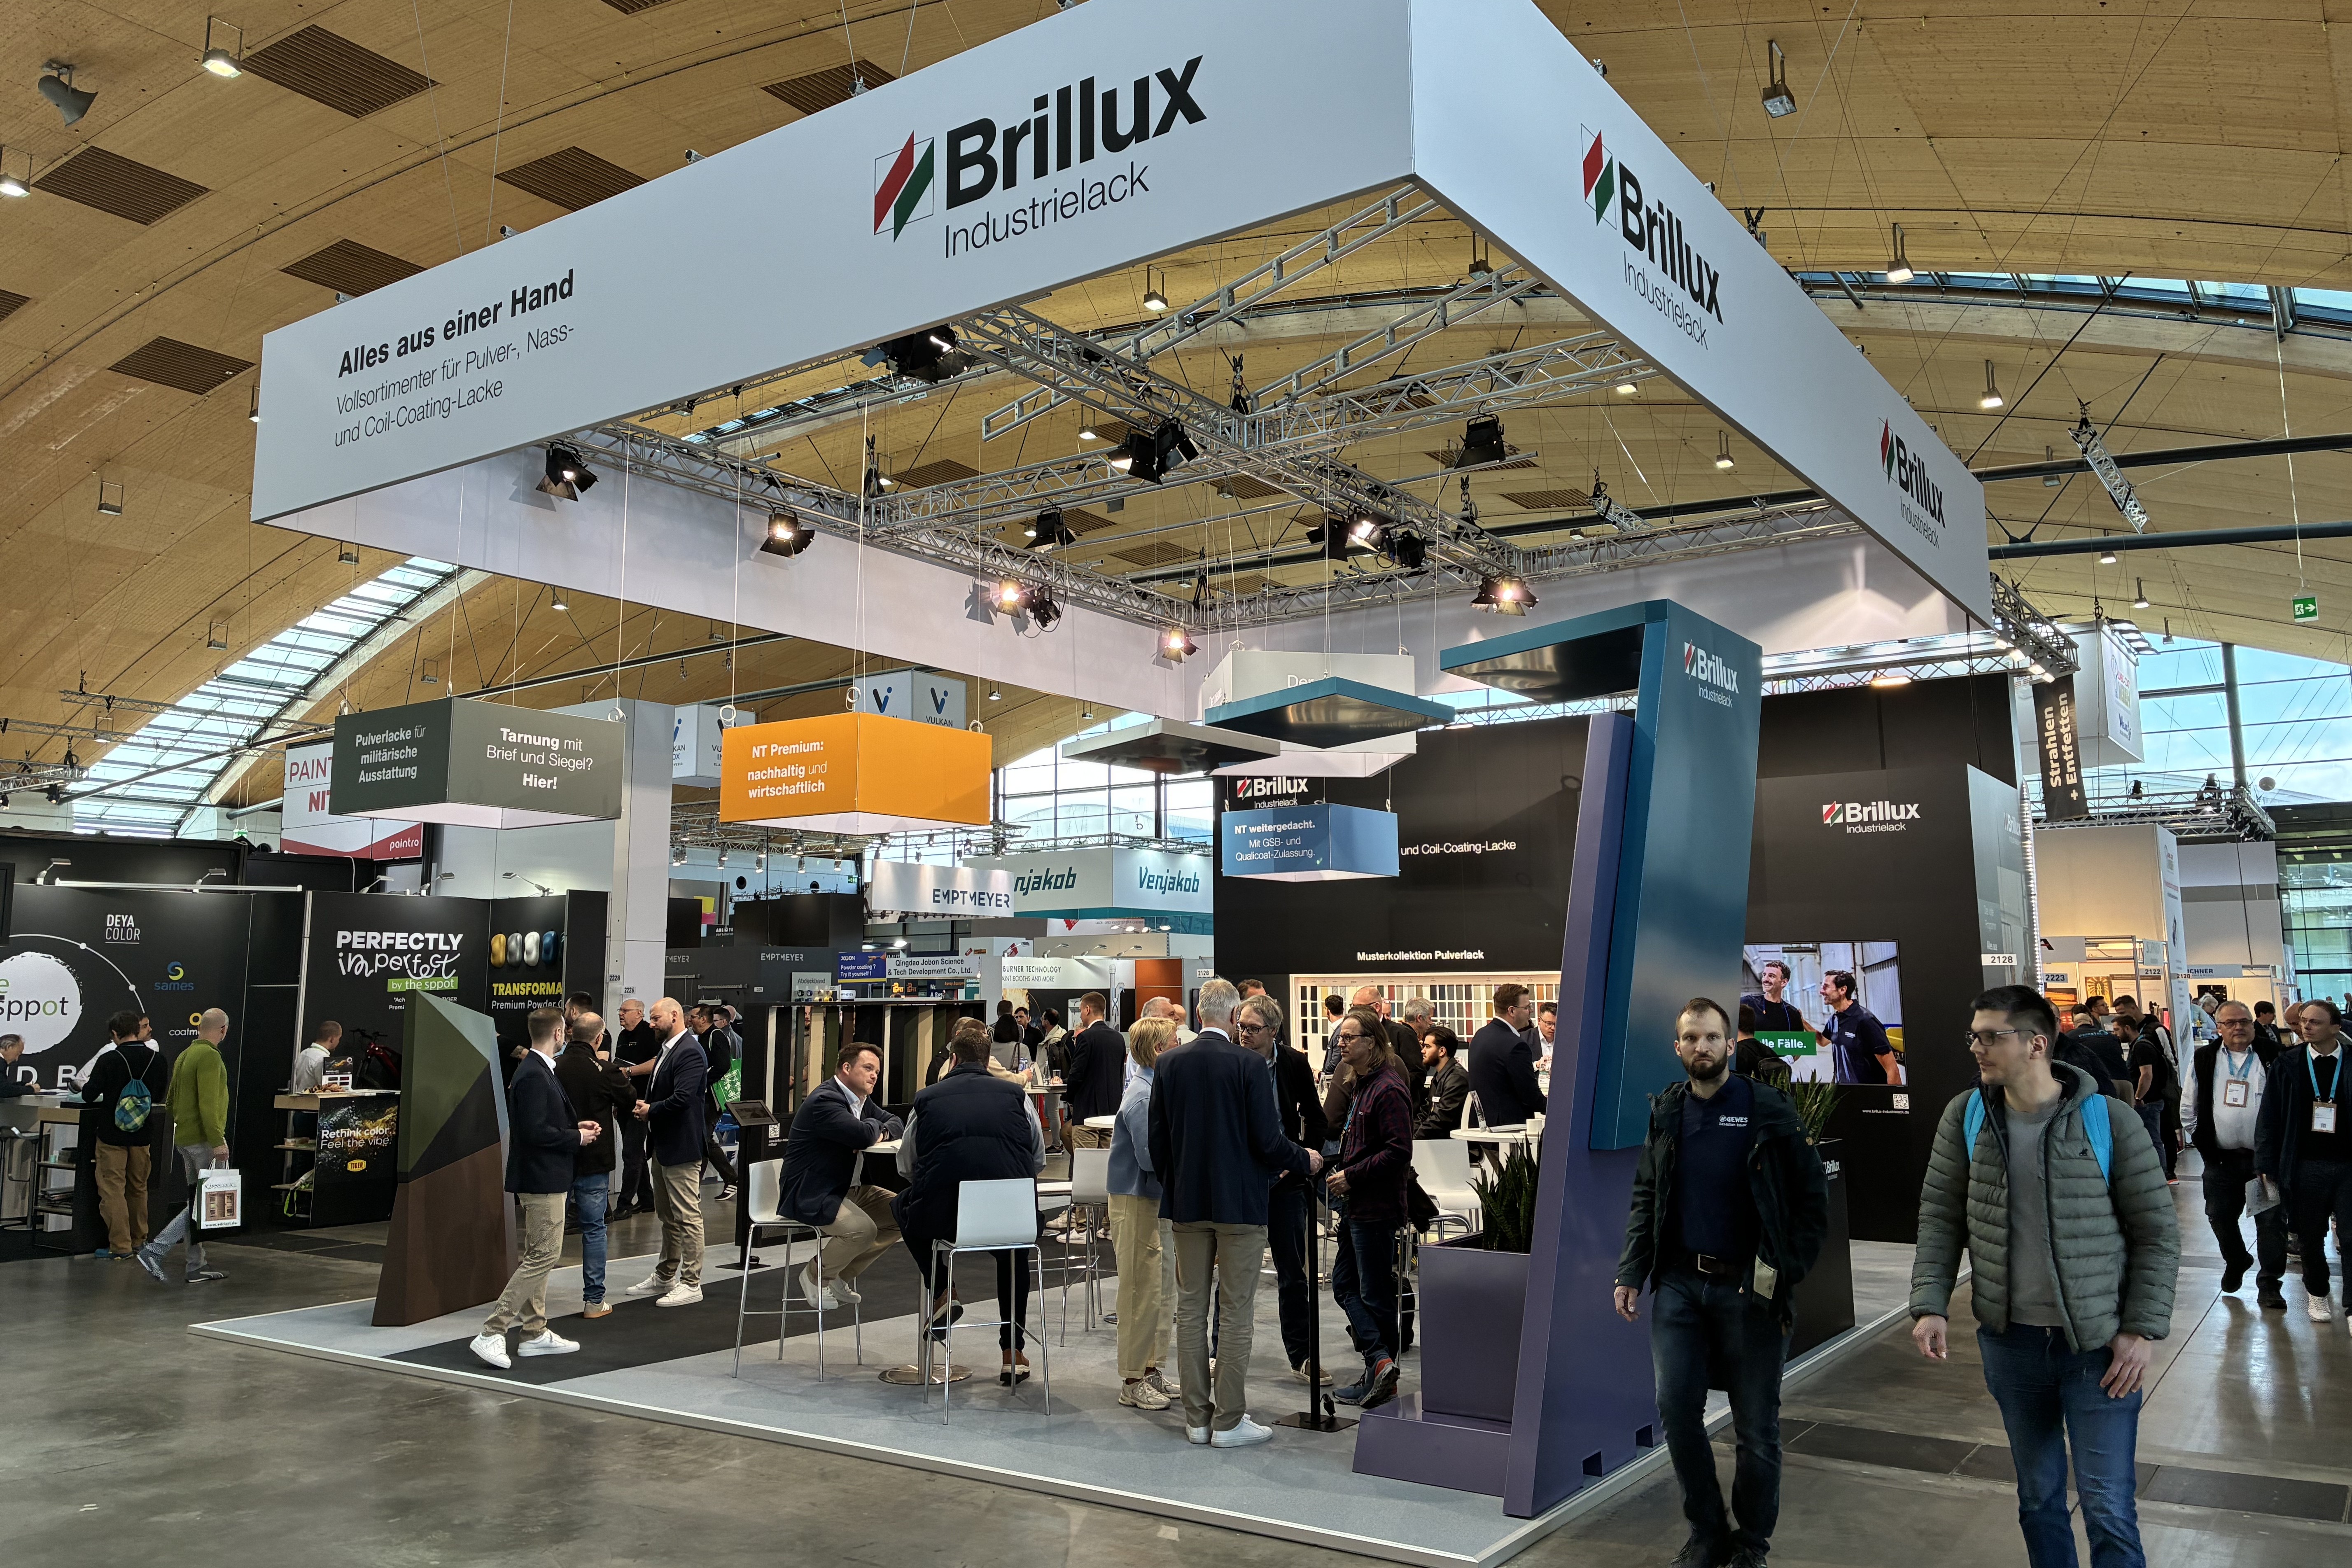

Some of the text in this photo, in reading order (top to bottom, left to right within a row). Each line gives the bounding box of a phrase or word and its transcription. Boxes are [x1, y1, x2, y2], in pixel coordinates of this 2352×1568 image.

[946, 55, 1207, 210] Brillux
[946, 161, 1149, 258] Industrielack
[1619, 161, 1723, 325] Brillux
[1624, 251, 1708, 350] Industrielack
[339, 268, 574, 377] Alles aus einer Hand
[336, 327, 574, 415] Vollsortimenter für Pulver-, Nass-
[335, 379, 503, 447] und Coil-Coating-Lacke
[1895, 434, 1946, 529] Brillux
[1900, 496, 1939, 550] Industrielack
[1697, 648, 1739, 694] Brillux
[1699, 684, 1733, 708] Industrielack
[926, 716, 953, 727] VULKAN
[356, 725, 426, 747] Pulverlacke für
[500, 728, 582, 751] Tarnung mit
[361, 745, 418, 764] militärische
[752, 741, 824, 758] NT Premium:
[2044, 706, 2061, 788] Strahlen
[2059, 693, 2078, 800] + Entfetten
[487, 745, 593, 771] Brief und Siegel?
[359, 766, 417, 783] Ausstattung
[748, 761, 827, 781] nachhaltig und
[523, 773, 557, 789] Hier!
[749, 779, 825, 798] wirtschaftlich
[1254, 776, 1309, 796] Brillux
[1255, 798, 1298, 809] Industrielack
[1846, 801, 1921, 822] Brillux
[1235, 820, 1315, 834] NT weitergedacht.
[1847, 822, 1906, 833] Industrielack
[390, 838, 419, 851] paintro
[1249, 836, 1301, 848] Mit GSB- und
[1401, 840, 1516, 855] und Coil-Coating-Lacke
[1236, 849, 1315, 861] Qualicoat-Zulassung.
[1139, 866, 1199, 895] Venjakob
[933, 889, 1010, 908] EMPTMEYER
[107, 914, 134, 927] DEYA
[106, 928, 140, 940] COLOR
[336, 931, 463, 950] PERFECTLY
[761, 953, 803, 961] EMPTMEYER
[896, 959, 919, 968] Qingdao
[1357, 950, 1484, 961] Musterkollektion Pulverlack
[338, 952, 460, 980] imperfect
[154, 982, 194, 990] sames
[392, 979, 454, 990] by the sppot
[492, 982, 562, 996] TRANSFORMA
[492, 1001, 525, 1009] Premium
[527, 999, 555, 1009] Powder
[169, 1028, 199, 1036] coatm
[1760, 1038, 1806, 1048] lle Fälle.
[322, 1128, 362, 1139] Rethink
[321, 1139, 344, 1149] Feel
[348, 1138, 365, 1147] the
